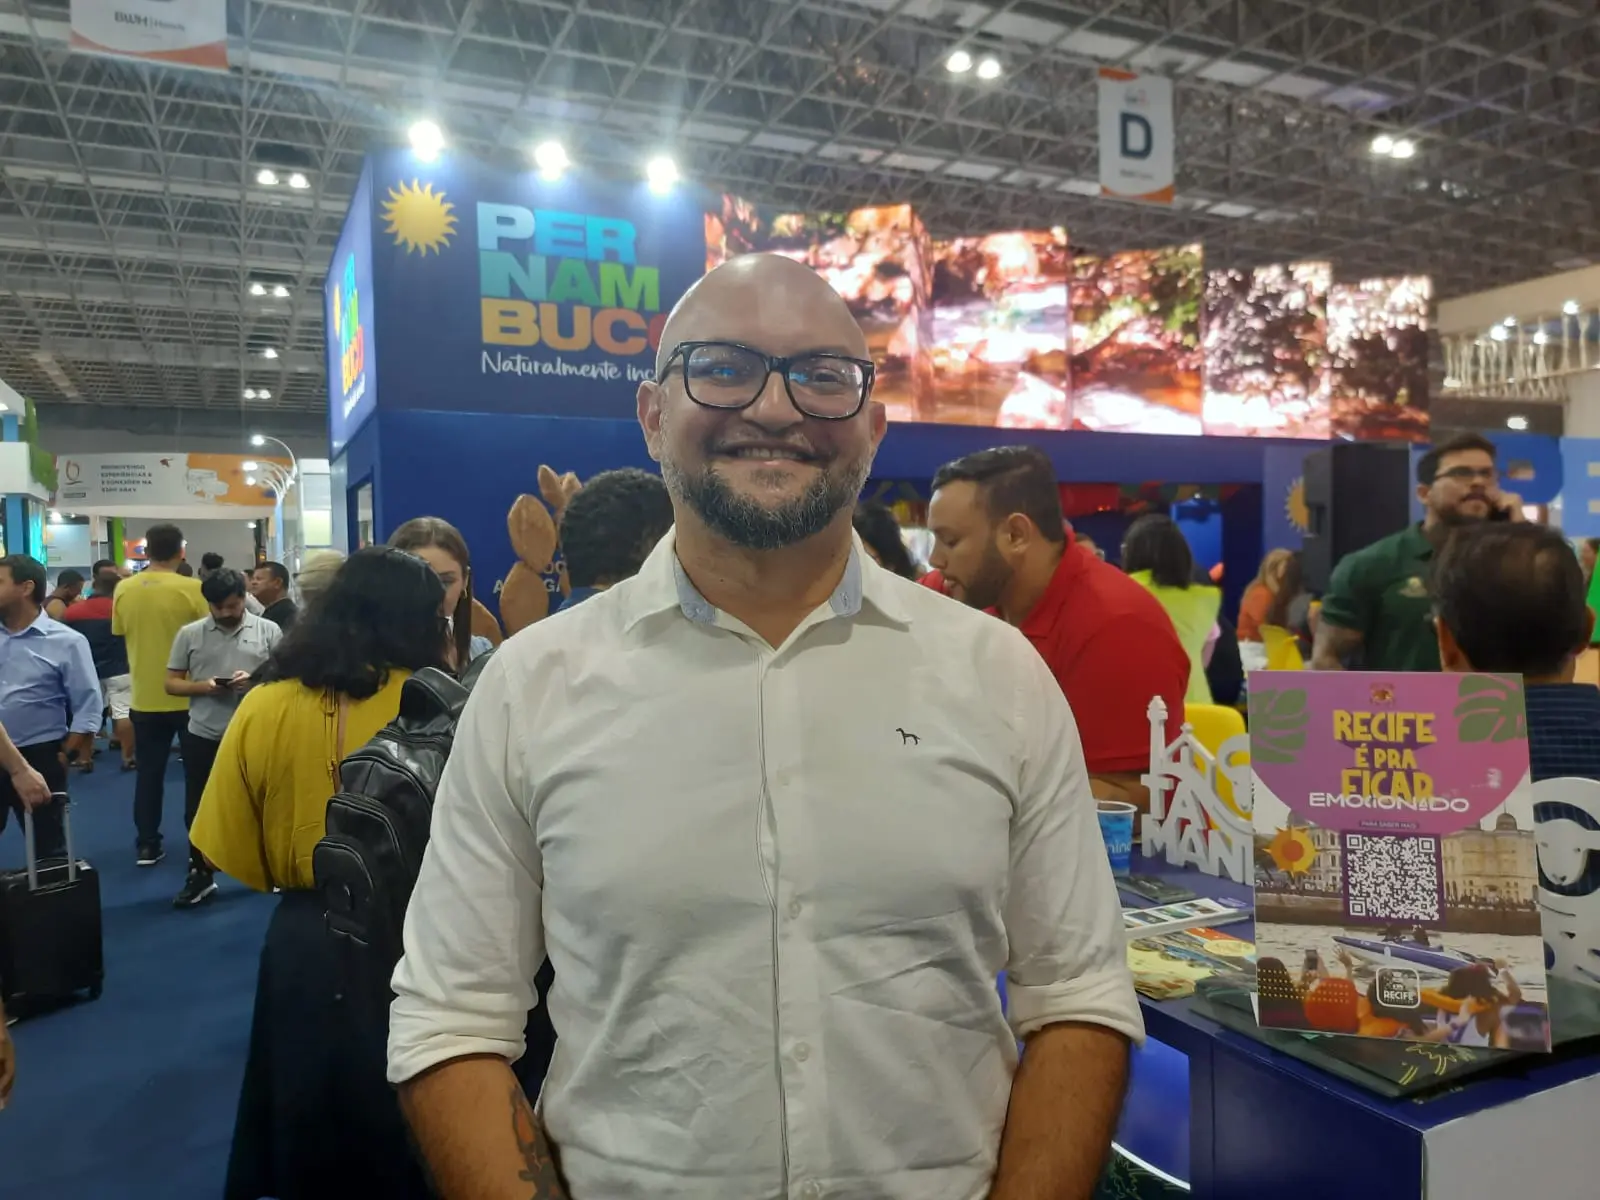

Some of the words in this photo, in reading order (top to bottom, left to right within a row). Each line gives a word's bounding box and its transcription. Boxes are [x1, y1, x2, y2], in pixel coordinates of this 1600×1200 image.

[1119, 112, 1153, 160] D
[476, 201, 637, 265] PER
[479, 250, 660, 311] NAM
[481, 351, 622, 381] Naturalmente
[1333, 709, 1437, 743] RECIFE
[1355, 744, 1369, 768] É
[1374, 748, 1418, 770] PRA
[1308, 791, 1470, 813] EMOCIONADO
[1383, 990, 1413, 1000] RECIFE
